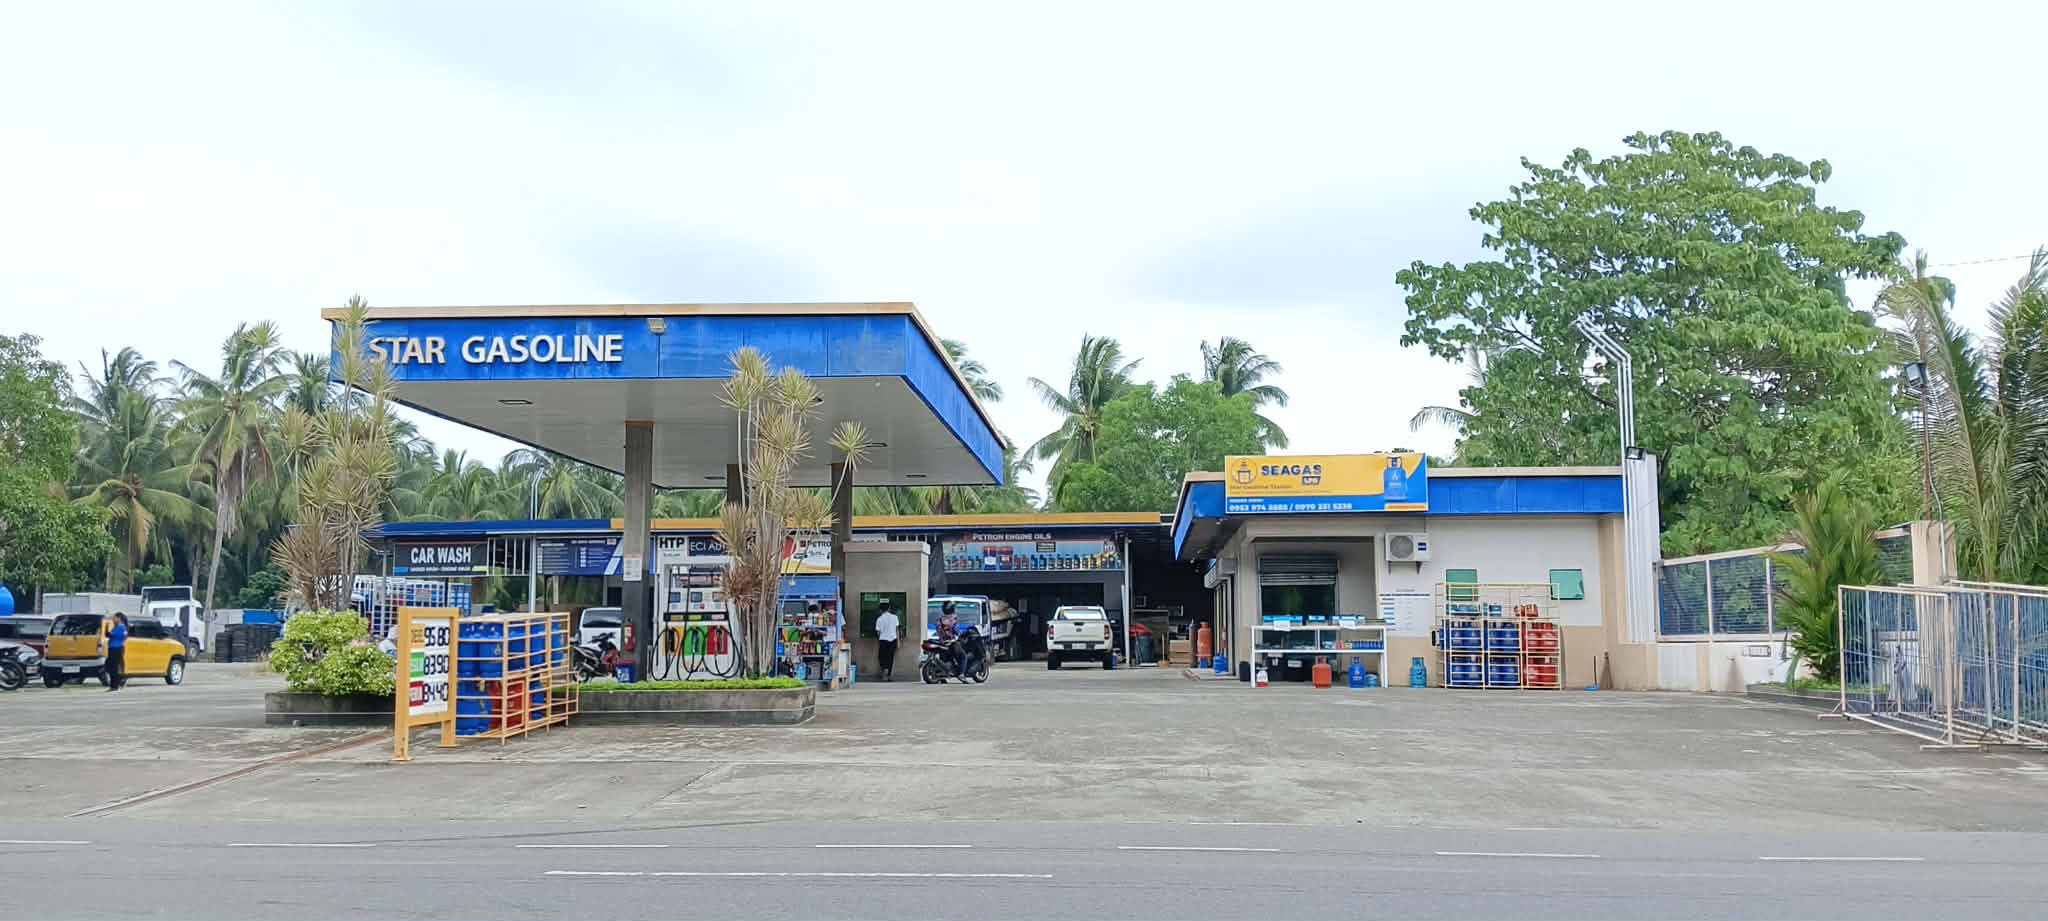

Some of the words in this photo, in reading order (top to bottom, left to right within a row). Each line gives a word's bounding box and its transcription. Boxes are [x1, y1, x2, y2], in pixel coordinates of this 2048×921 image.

[368, 336, 445, 364] STAR
[461, 334, 623, 363] GASOLINE
[1261, 464, 1321, 476] SEAGAS
[659, 537, 685, 548] HTP
[972, 533, 1004, 541] PETRON
[410, 547, 435, 564] CAR
[437, 547, 472, 564] WASH
